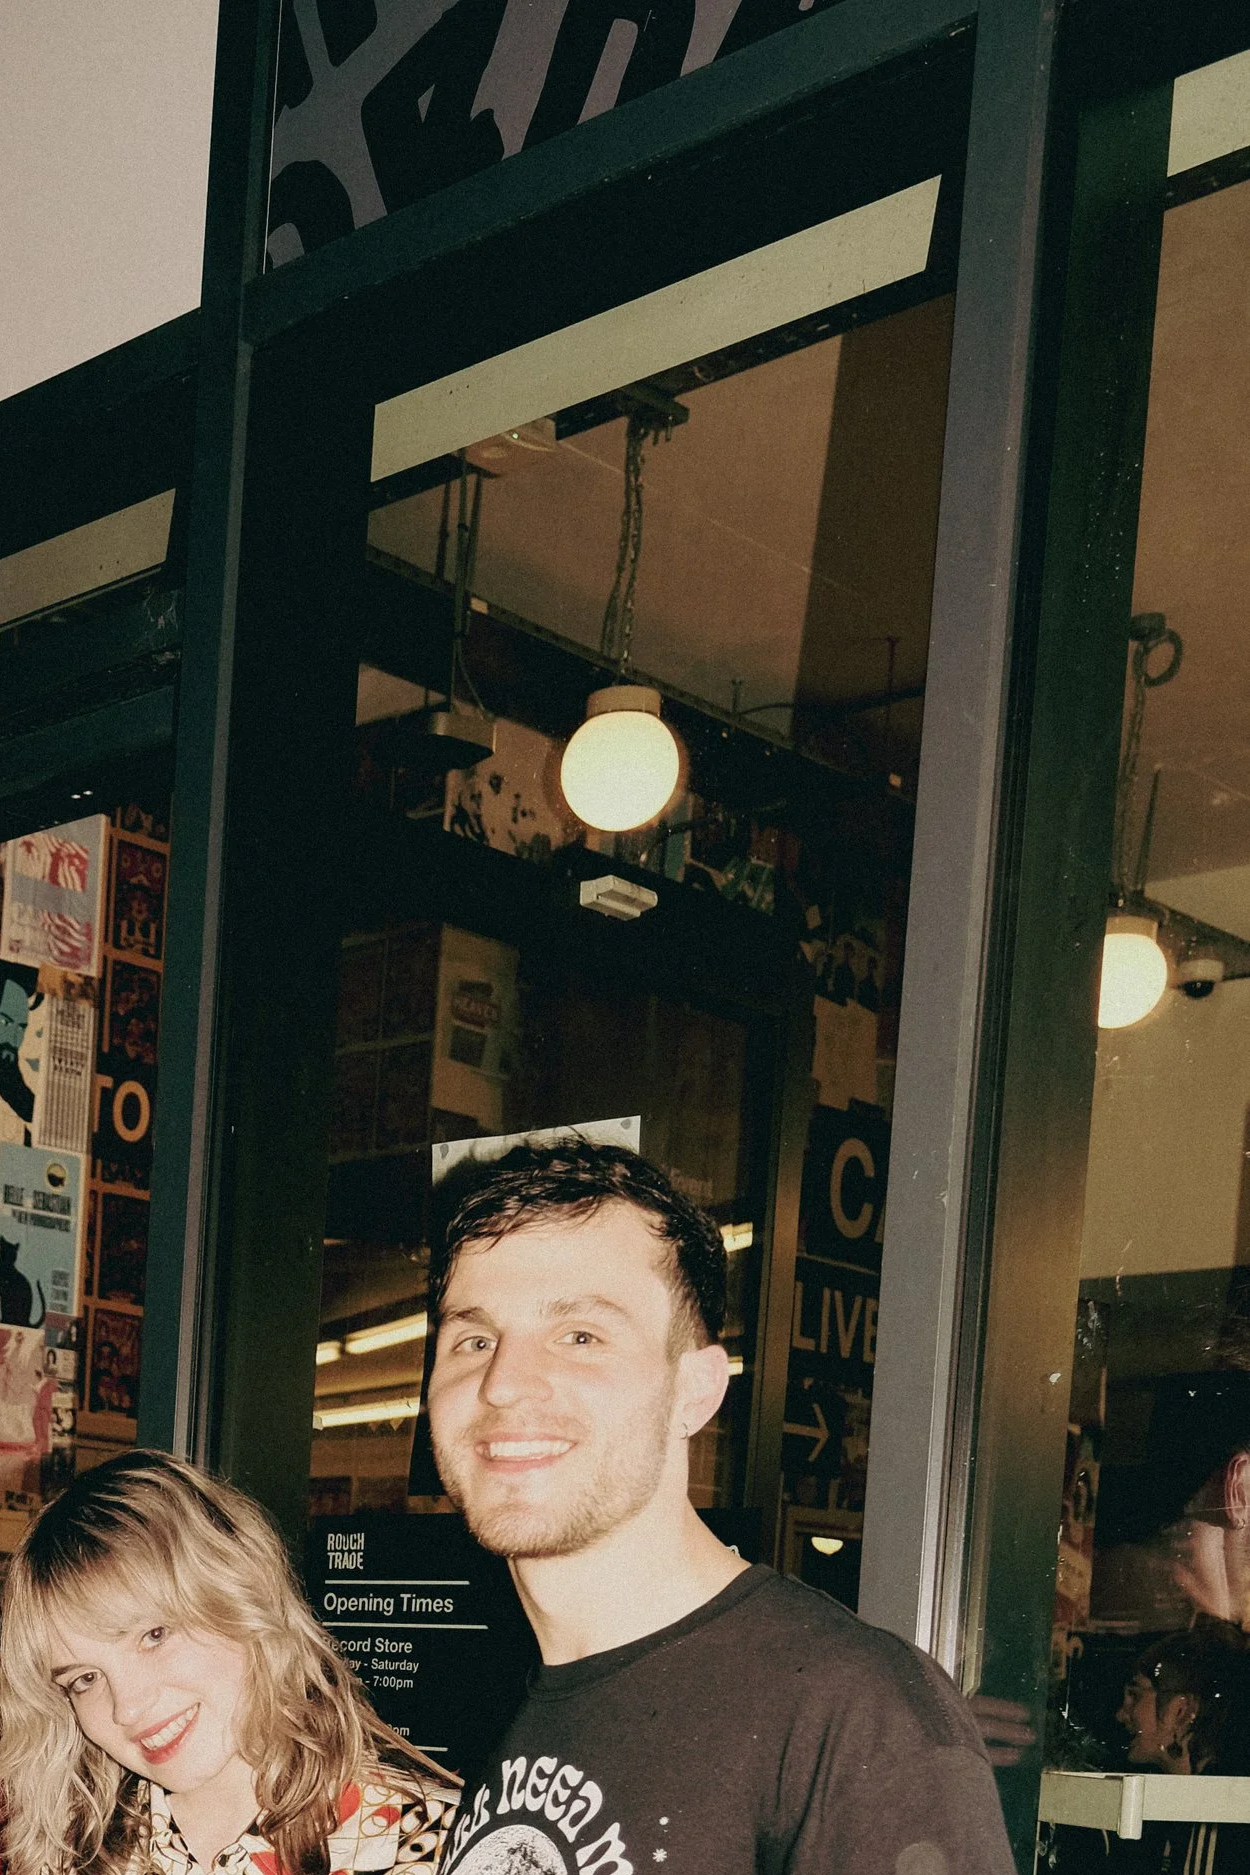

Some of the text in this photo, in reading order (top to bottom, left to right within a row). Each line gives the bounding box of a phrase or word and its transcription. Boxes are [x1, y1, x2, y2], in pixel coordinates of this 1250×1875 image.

[830, 1137, 886, 1244] C
[791, 1280, 880, 1364] LIVE
[327, 1532, 365, 1551] ROUGH
[327, 1552, 364, 1570] TRADE
[323, 1592, 454, 1616] Opening Times
[374, 1637, 413, 1653] Store
[371, 1658, 420, 1673] Saturday
[373, 1675, 414, 1690] 7:00pm
[496, 1756, 603, 1843] NEED
